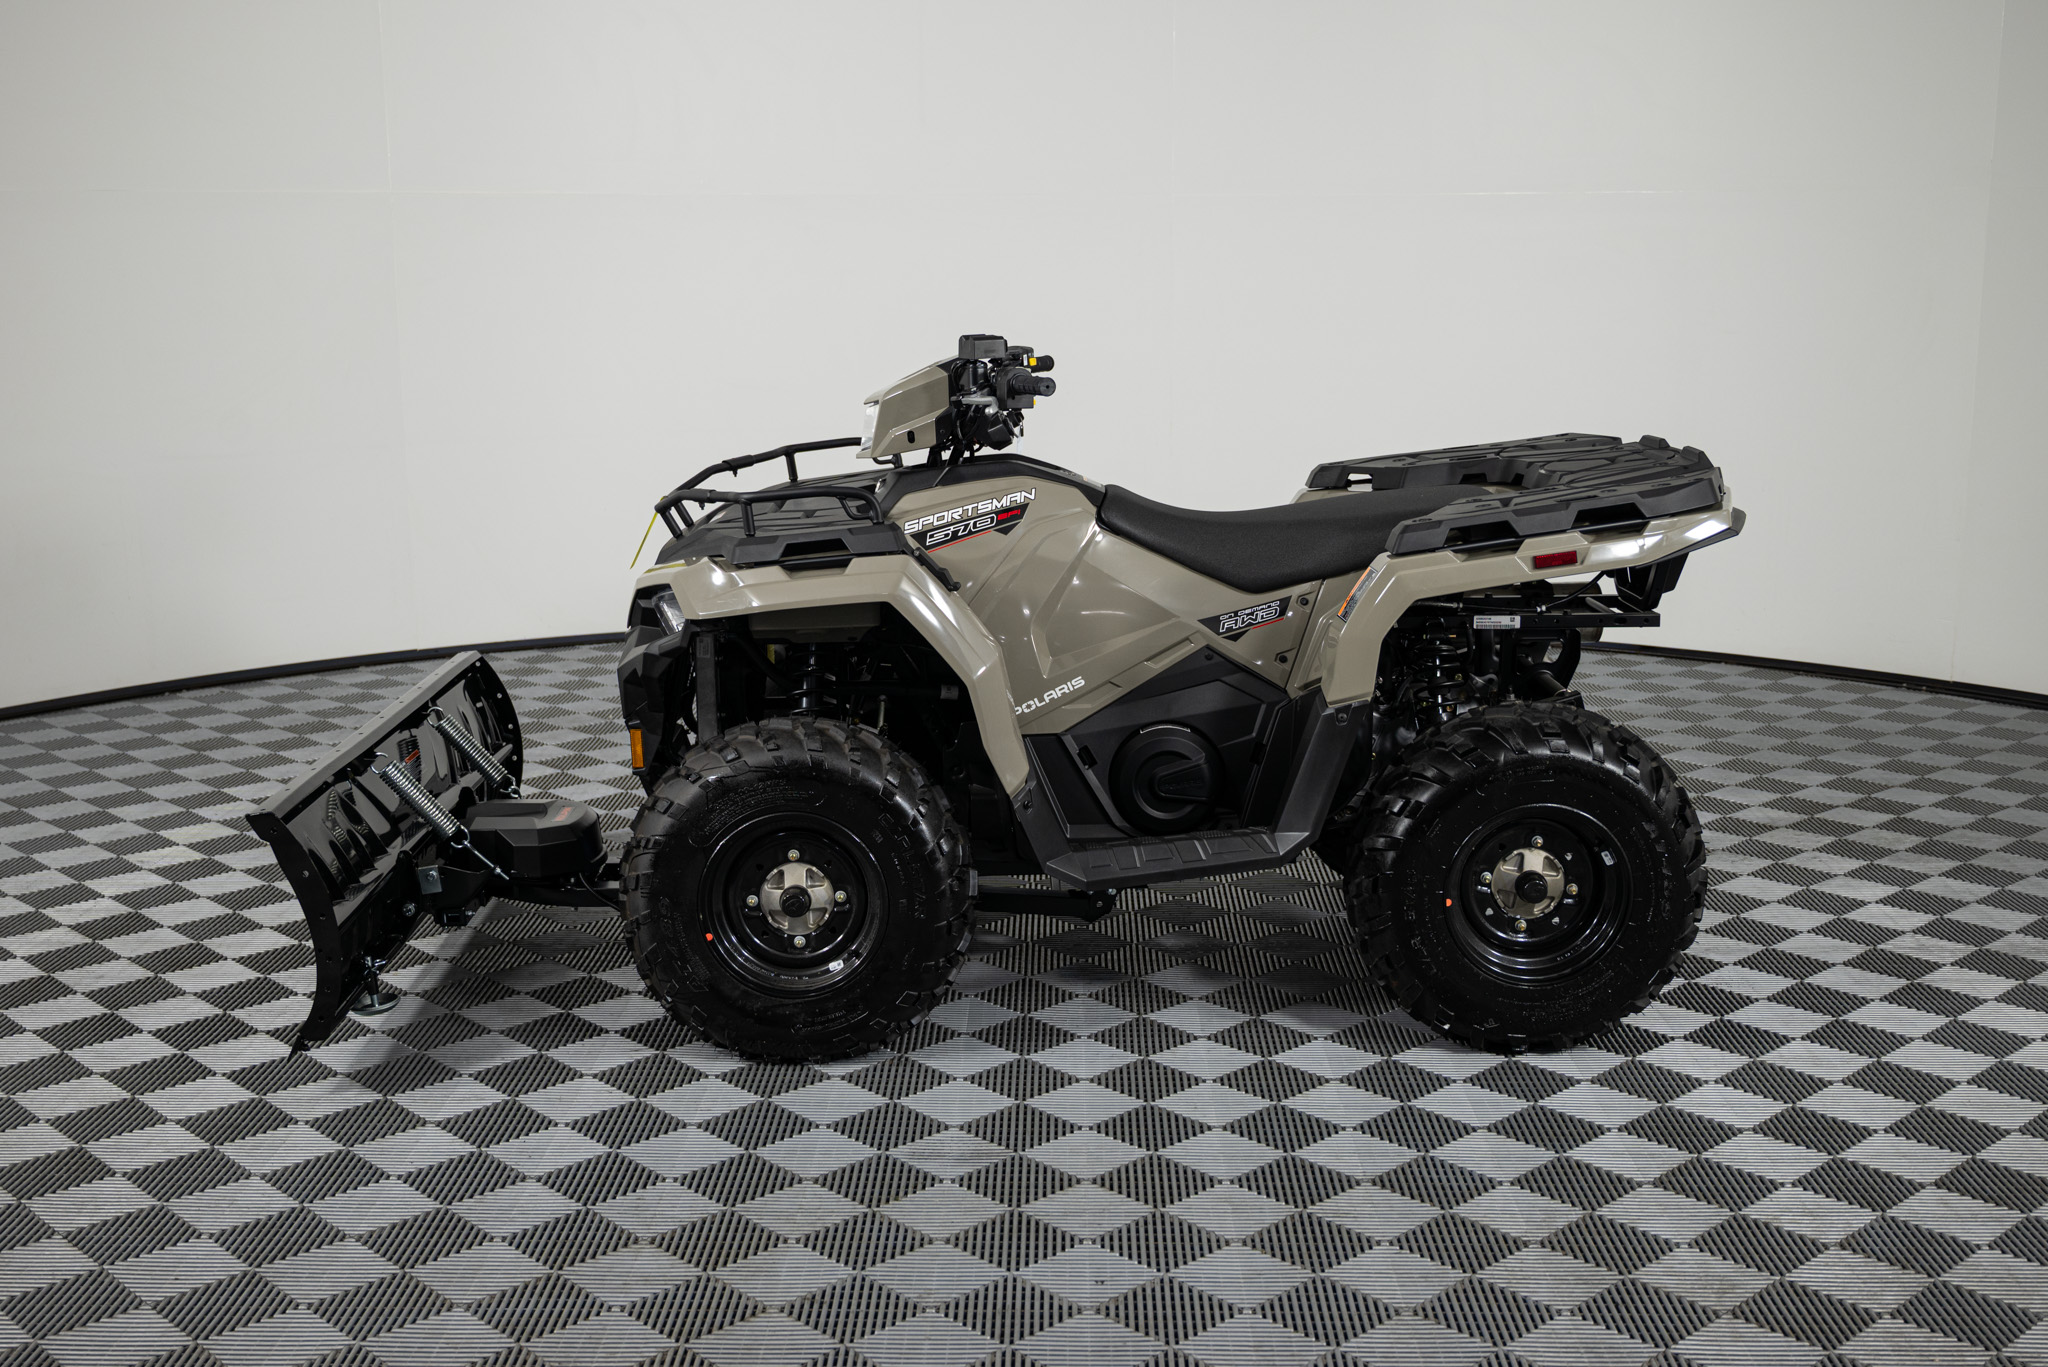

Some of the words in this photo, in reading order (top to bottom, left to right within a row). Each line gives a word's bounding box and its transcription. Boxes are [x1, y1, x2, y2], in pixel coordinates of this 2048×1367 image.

[904, 488, 1036, 534] SPORTSMAN
[926, 513, 997, 546] 570
[1219, 606, 1280, 632] AWD
